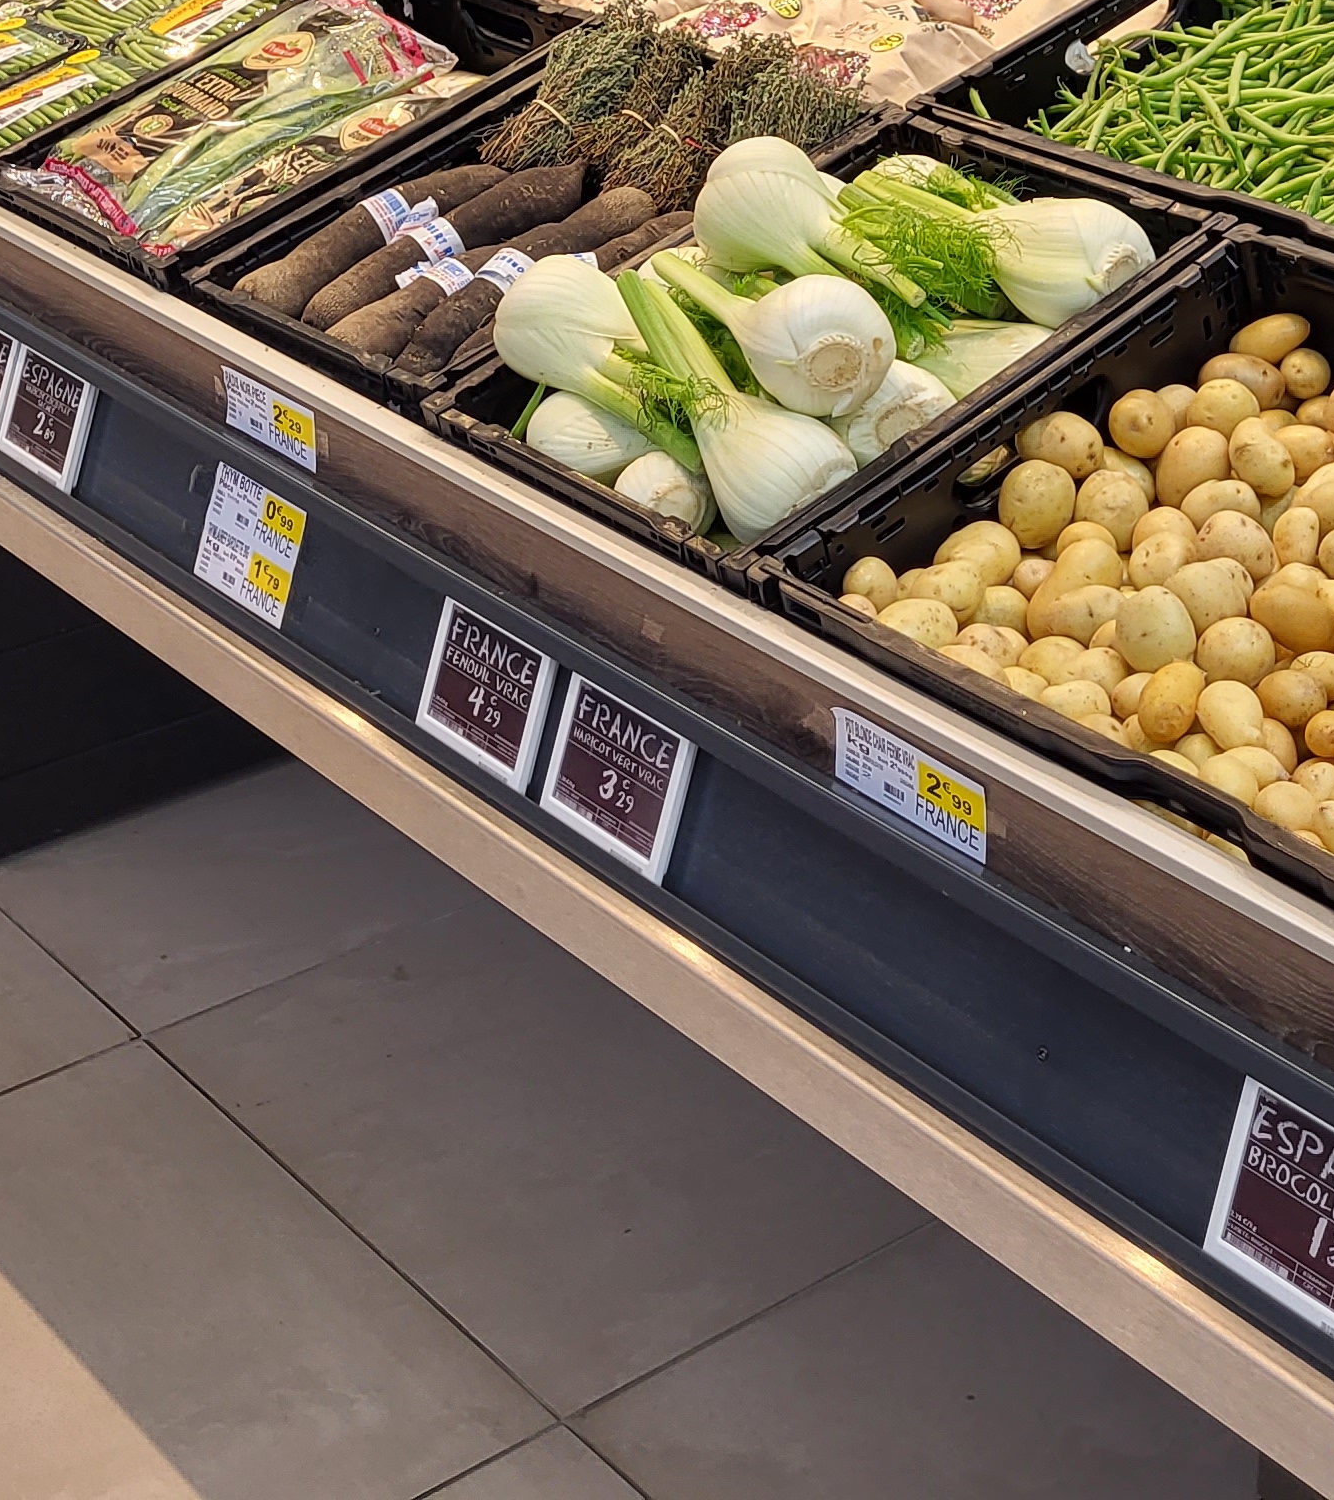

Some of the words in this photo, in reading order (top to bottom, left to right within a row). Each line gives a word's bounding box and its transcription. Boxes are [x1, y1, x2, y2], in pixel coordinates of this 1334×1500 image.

[22, 358, 84, 410] ESPAGNE
[268, 420, 309, 462] FRANCE
[220, 463, 239, 487] THYM
[238, 473, 264, 501] BOTTE
[252, 518, 295, 559] FRANCE
[239, 576, 281, 618] FRANCE
[450, 616, 537, 686] FRANCE
[445, 646, 492, 685] FENOUIL
[495, 674, 529, 709] VRAC
[578, 693, 674, 770] FRANCE
[847, 733, 871, 756] kg
[572, 725, 612, 757] HARICOT
[612, 747, 638, 775] VERT
[637, 763, 665, 792] VRAC
[926, 772, 973, 817] 2€99
[915, 794, 980, 852] FRANCE
